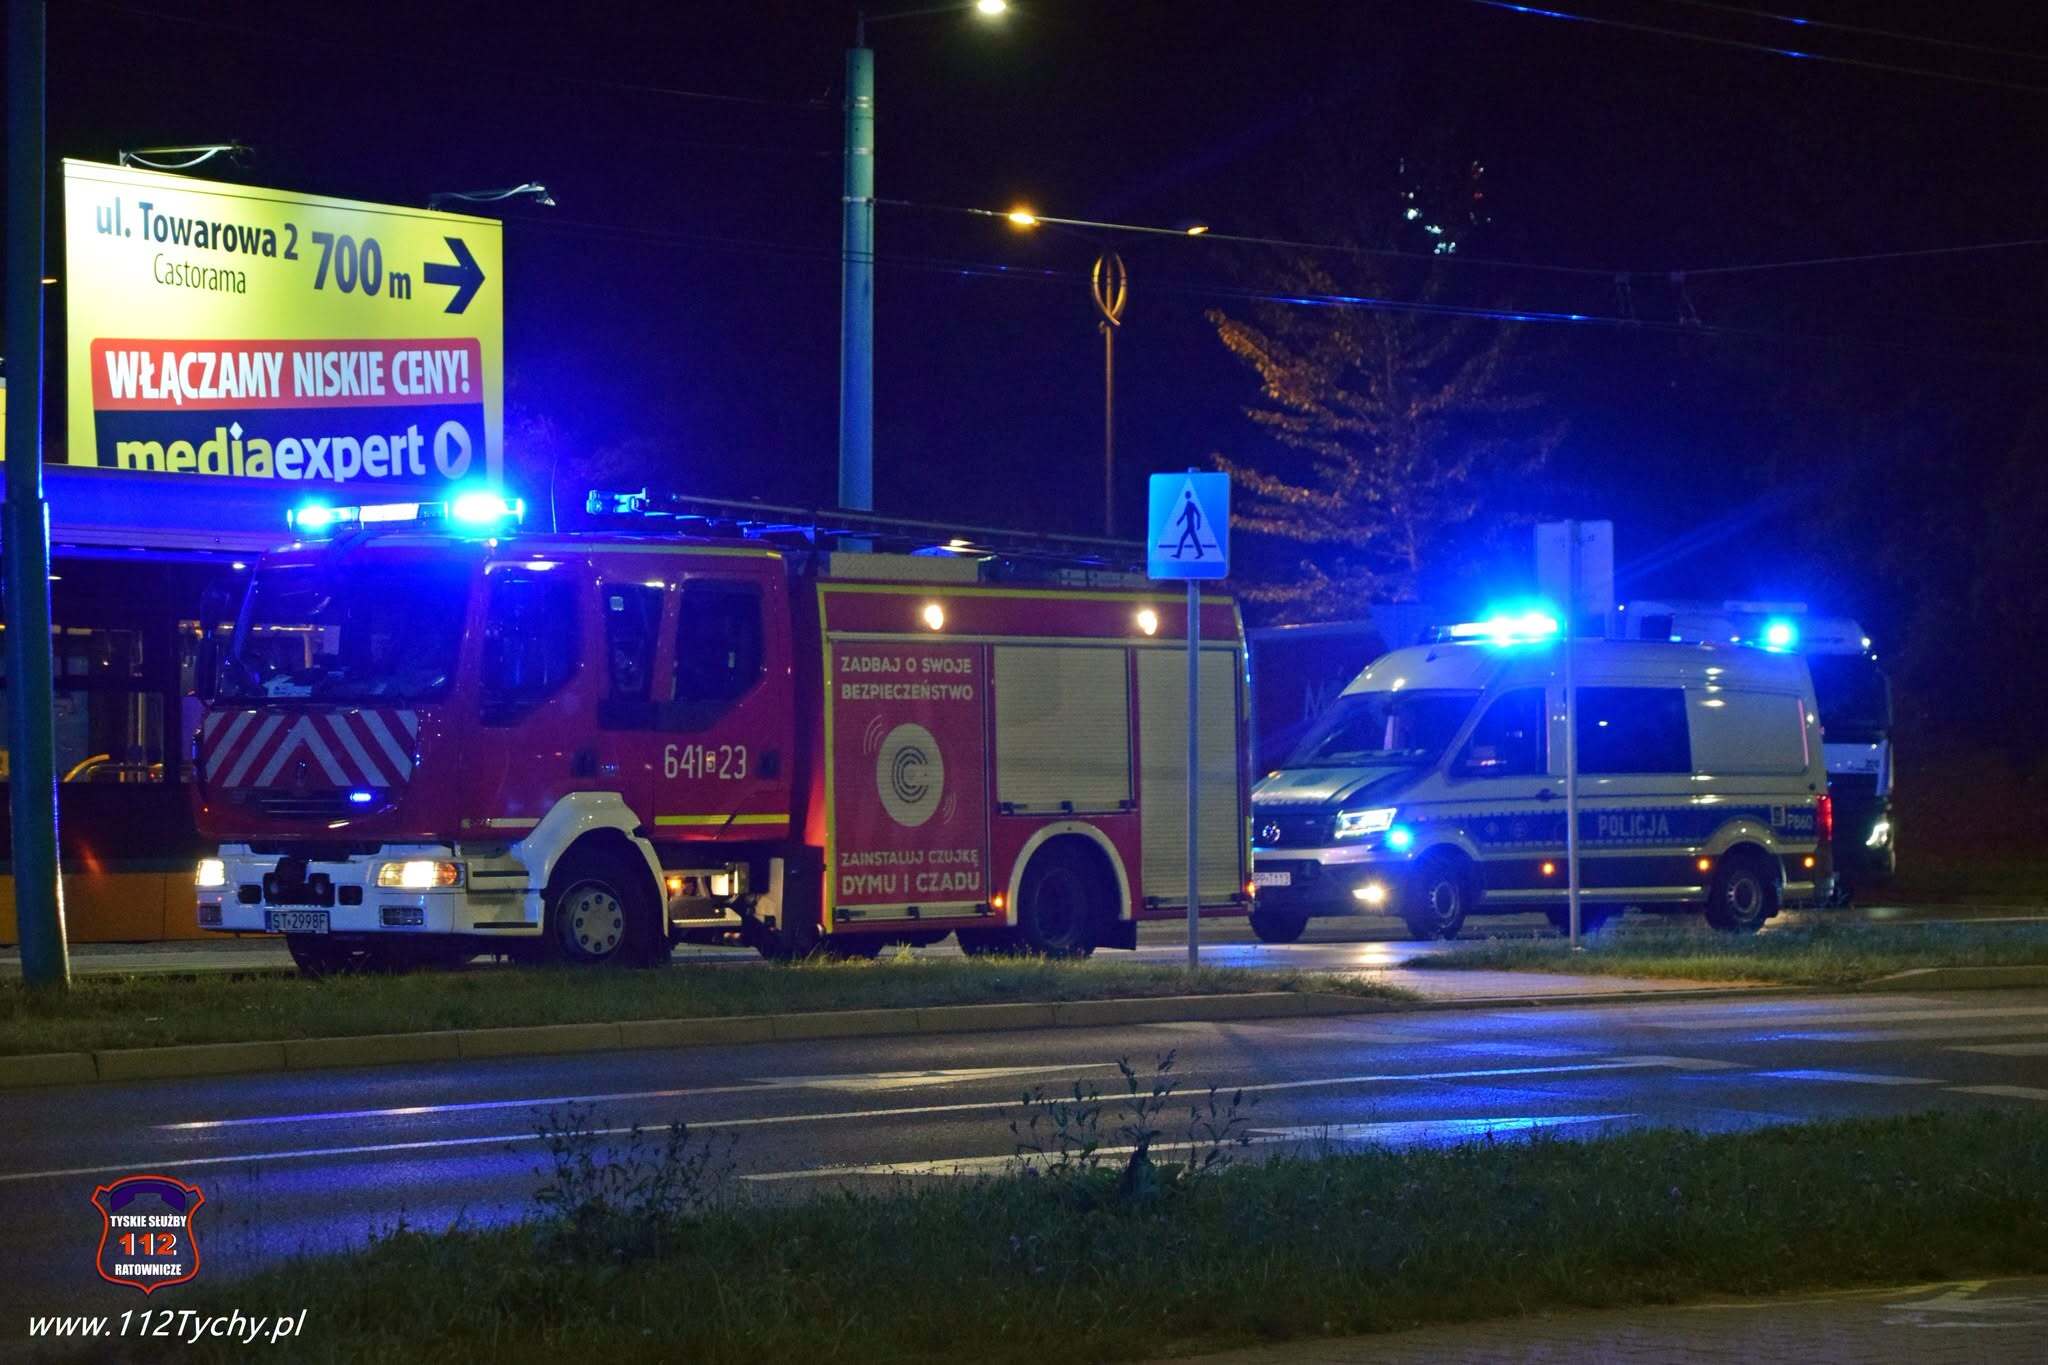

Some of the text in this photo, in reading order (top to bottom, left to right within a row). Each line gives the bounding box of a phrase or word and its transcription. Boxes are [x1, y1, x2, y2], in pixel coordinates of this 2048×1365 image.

[96, 197, 299, 260] ul. Towarowa 2
[153, 253, 247, 295] Castorama
[311, 232, 412, 300] 700 m
[105, 349, 470, 406] WŁĄCZAMY NISKIE CENY!
[115, 421, 426, 484] mediaexpert
[840, 656, 973, 674] ZADBAJ O SWOJE
[841, 679, 974, 700] BEZPIECZEŃSTWO
[1599, 813, 1670, 837] POLICJA
[841, 849, 980, 868] ZAINSTALUJ CZUJKĘ
[842, 872, 980, 896] DYMU I CZADU
